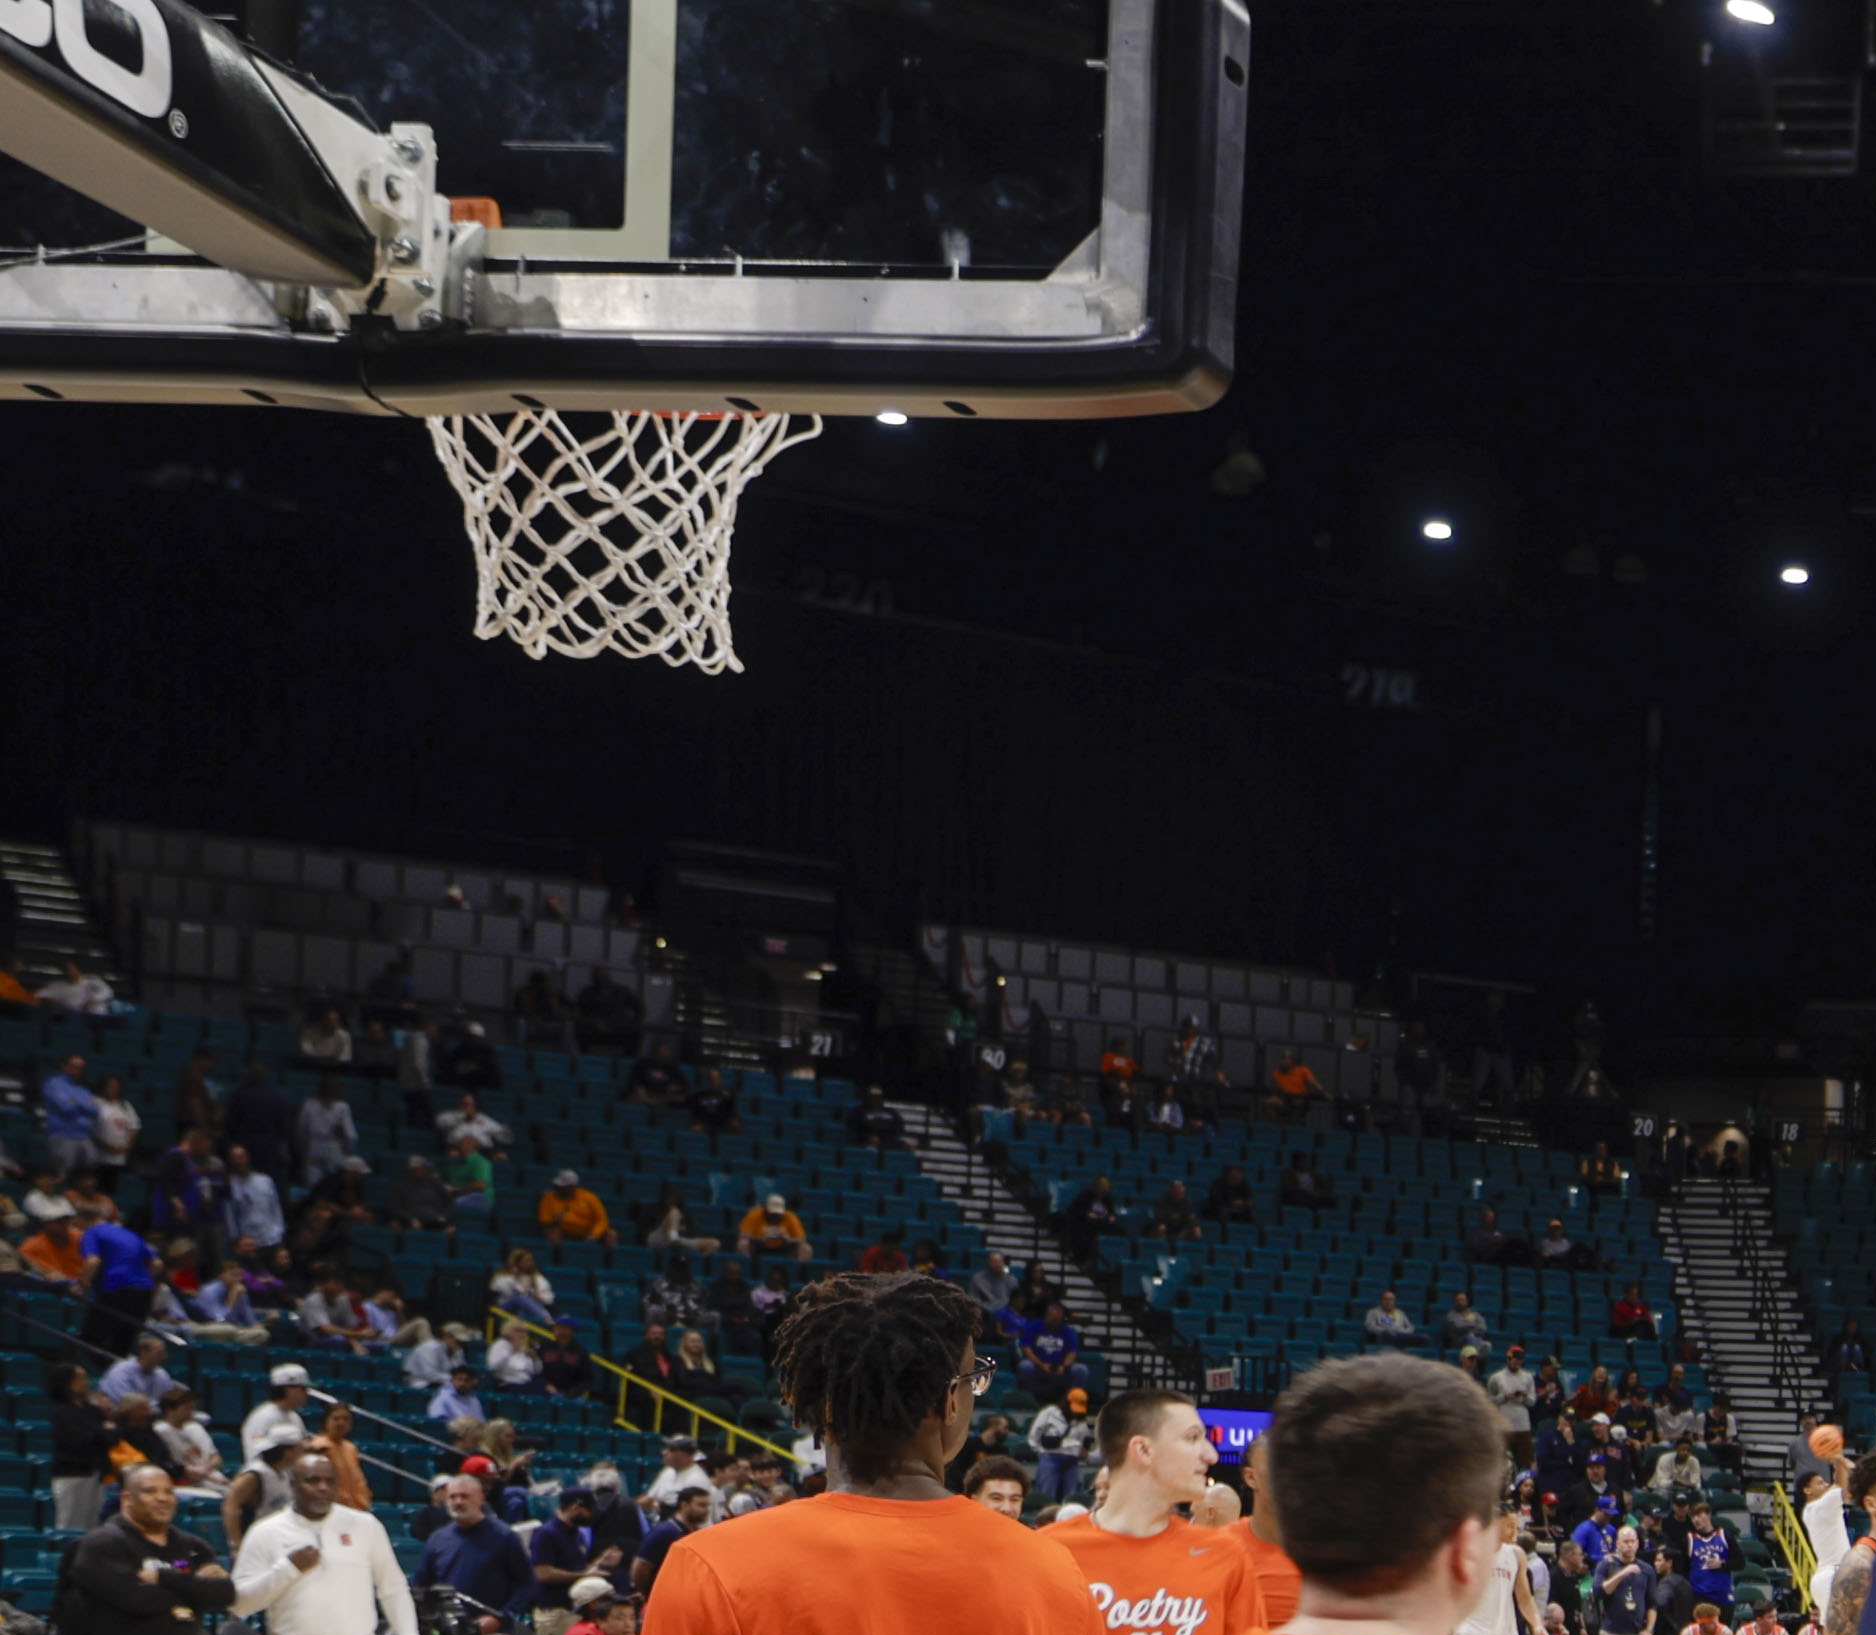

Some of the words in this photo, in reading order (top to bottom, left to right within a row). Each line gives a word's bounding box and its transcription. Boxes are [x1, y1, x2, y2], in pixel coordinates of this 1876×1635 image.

[810, 1034, 833, 1057] 21
[1633, 1116, 1655, 1137] 20
[1781, 1122, 1800, 1142] 18
